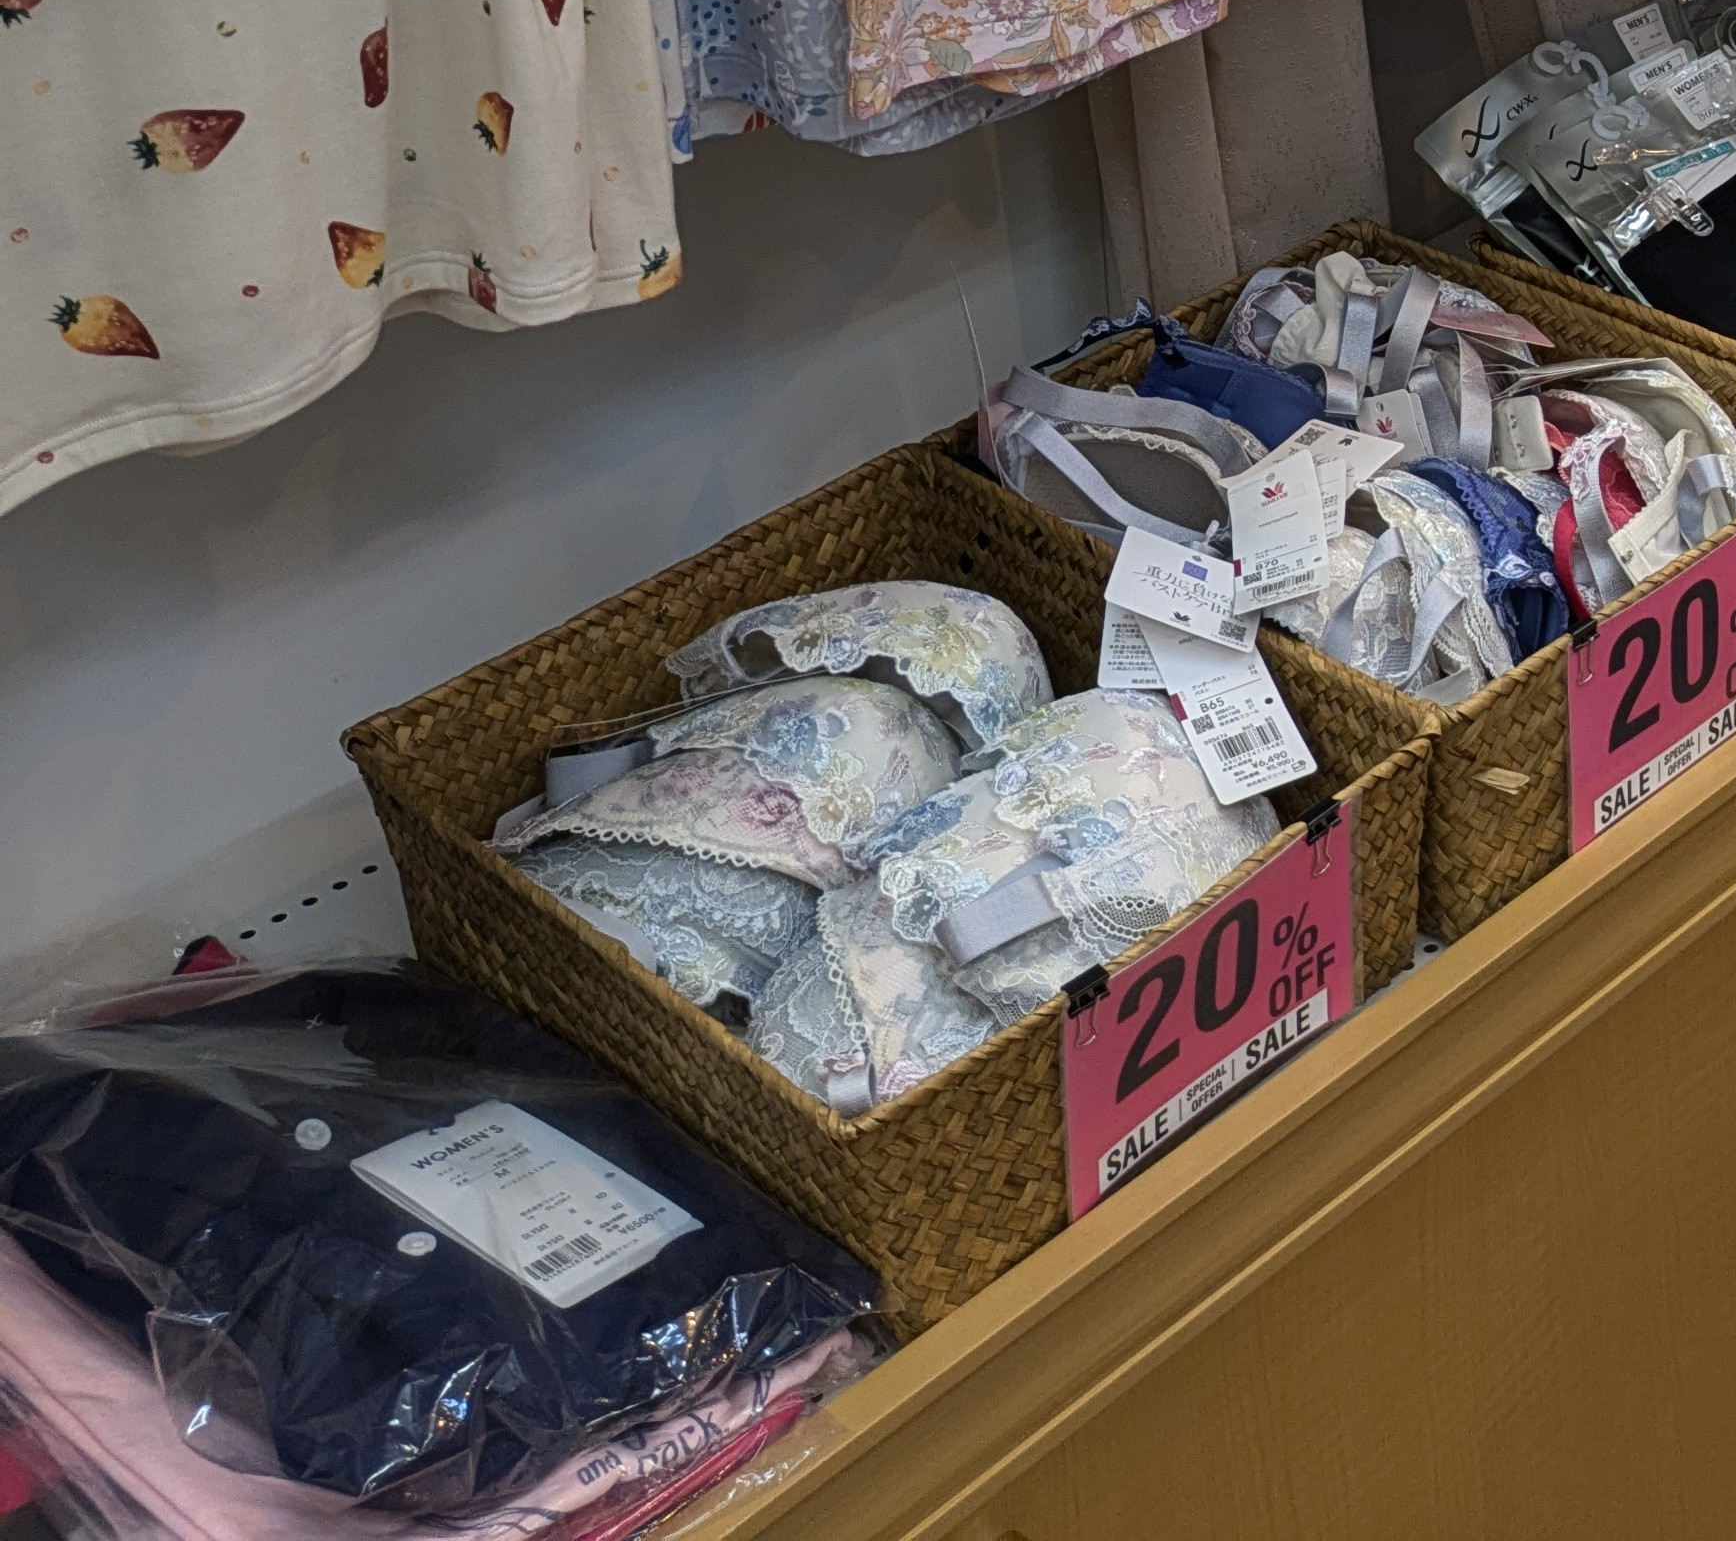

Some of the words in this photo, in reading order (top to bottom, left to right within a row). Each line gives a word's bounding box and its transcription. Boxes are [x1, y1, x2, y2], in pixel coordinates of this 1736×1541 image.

[1626, 14, 1651, 30] MEN'S
[1645, 60, 1673, 81] MEN'S
[1199, 696, 1226, 714] B65
[1664, 736, 1695, 766] SPECIAL
[1666, 751, 1692, 777] OFFER
[1600, 769, 1651, 825] SALE
[1268, 941, 1337, 1018] OFF
[1245, 1002, 1312, 1071] SALE
[1186, 1063, 1227, 1103] SPECIAL
[1190, 1080, 1224, 1114] OFFER
[410, 1124, 505, 1170] WOMEN'S
[1106, 1107, 1170, 1182] SALE
